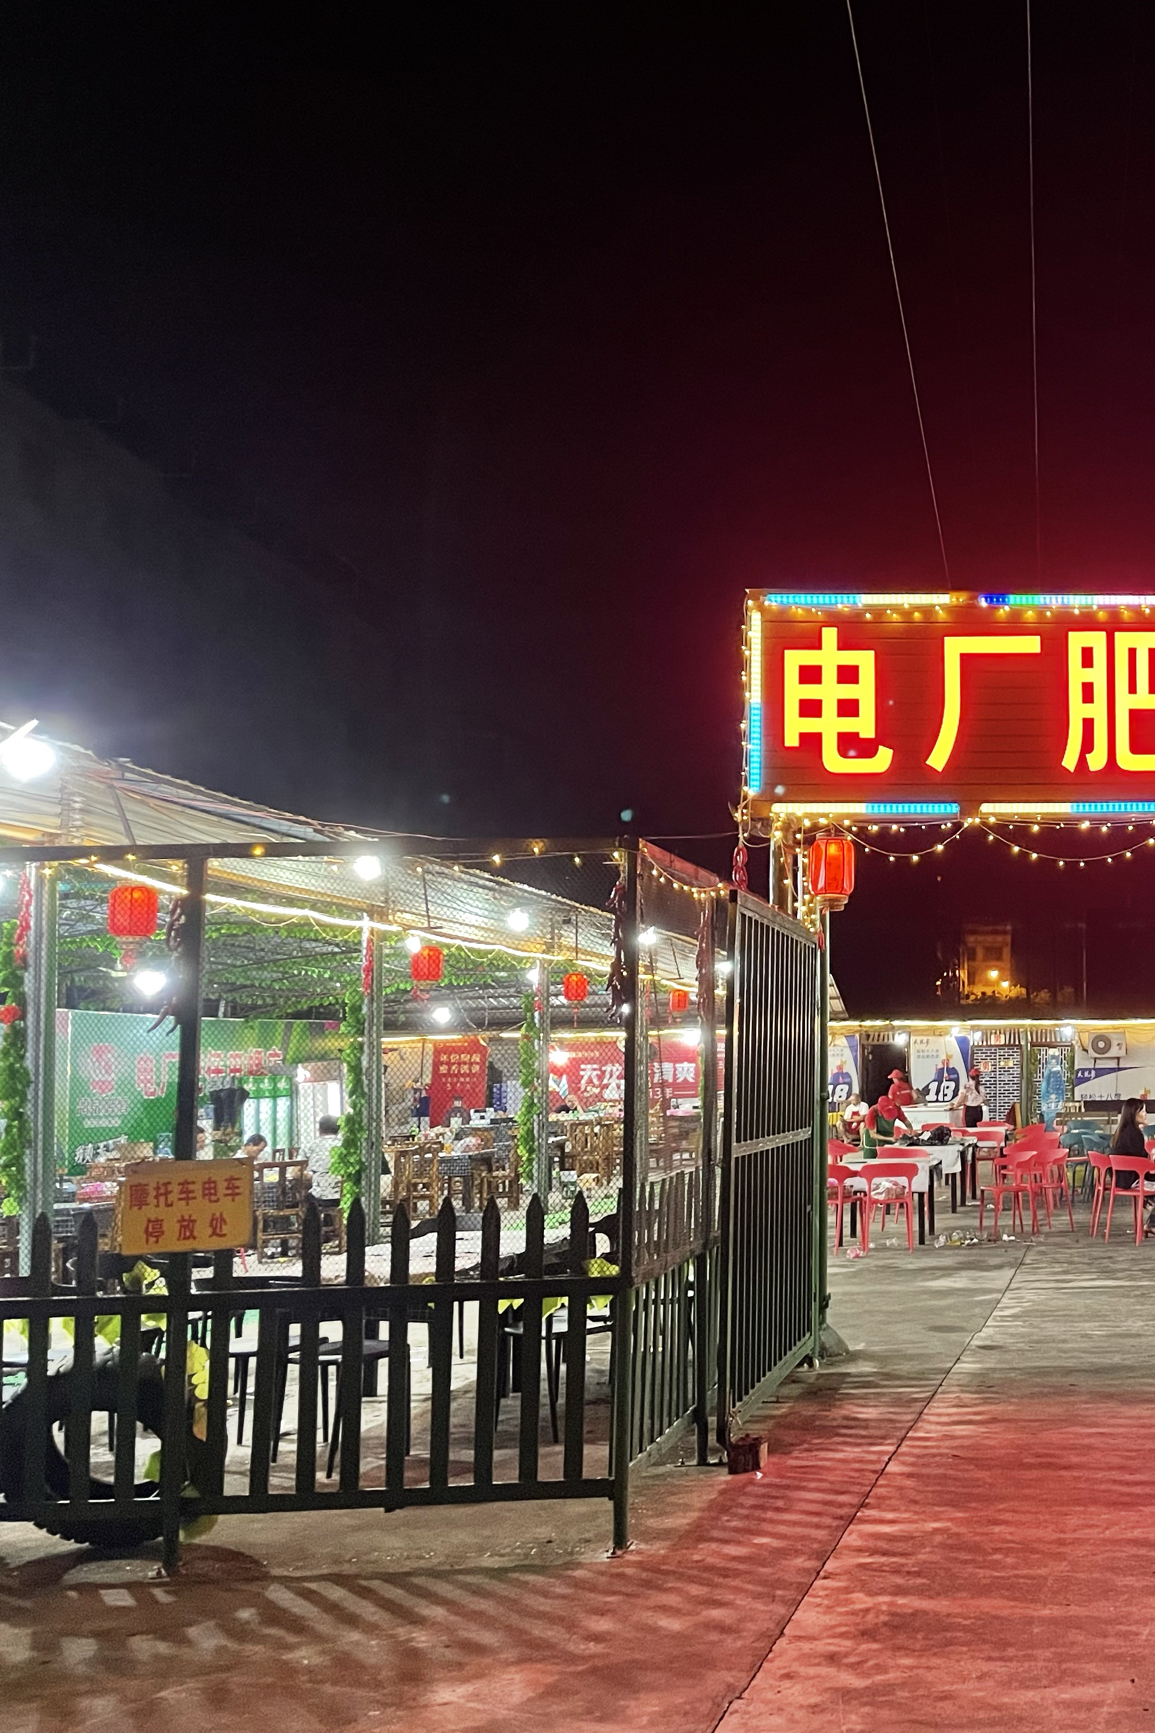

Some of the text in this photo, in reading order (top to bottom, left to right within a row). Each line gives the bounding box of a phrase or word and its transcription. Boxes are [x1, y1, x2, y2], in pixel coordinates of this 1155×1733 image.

[926, 1081, 956, 1102] 18
[128, 1175, 242, 1211] 摩托车电车
[144, 1211, 228, 1245] 停放处
